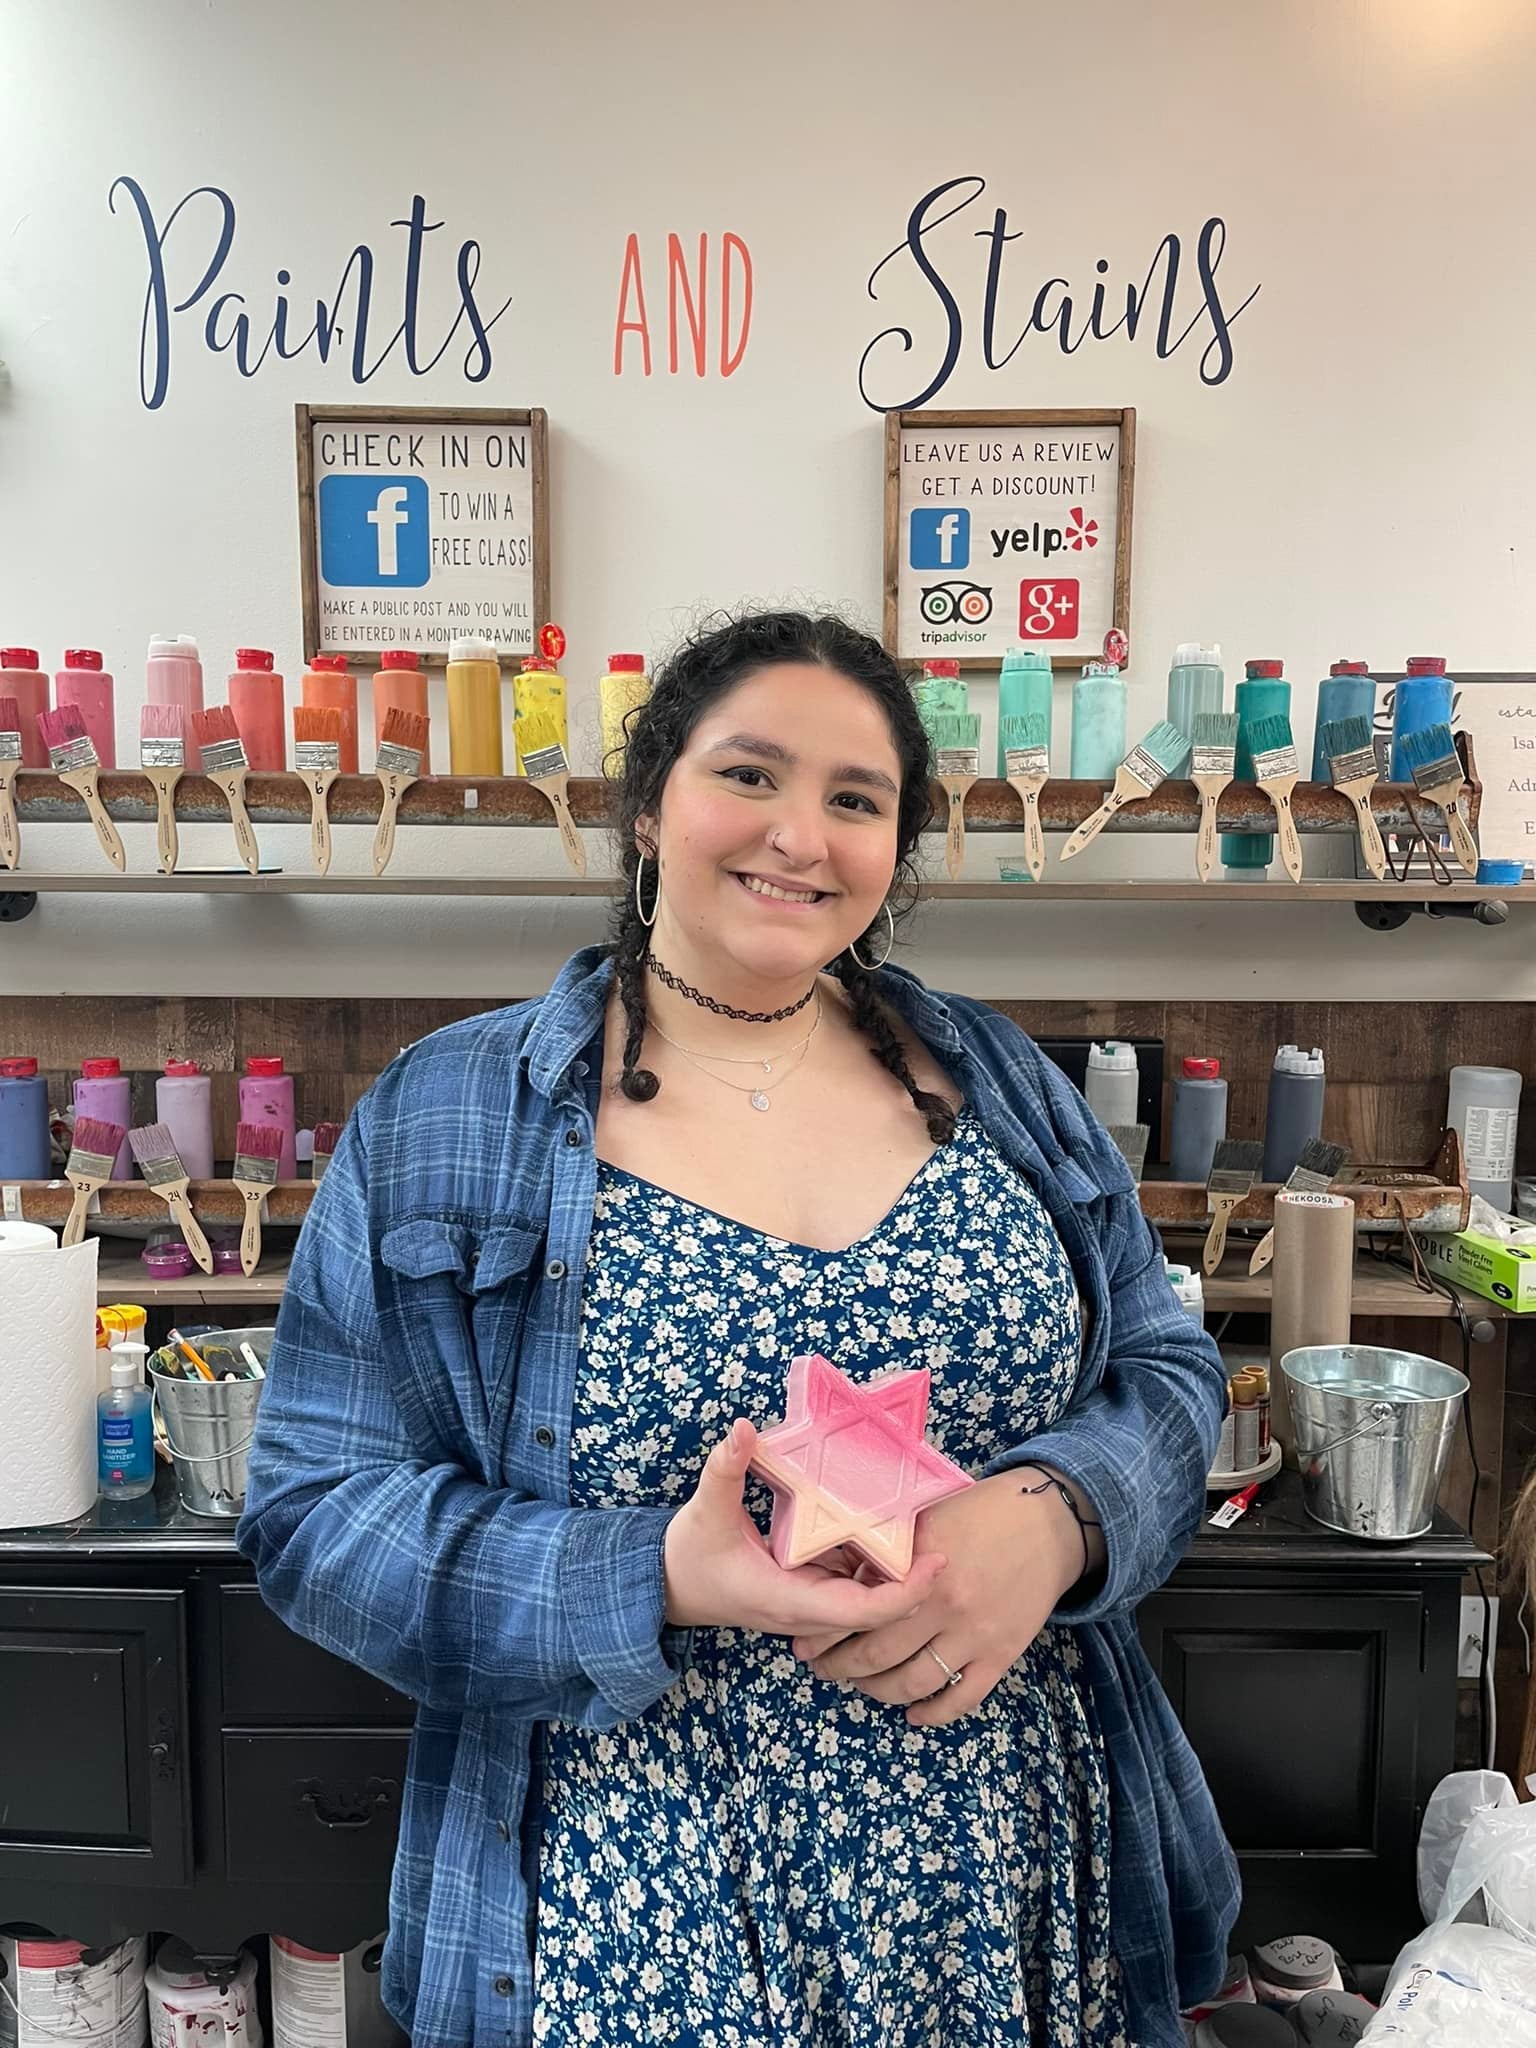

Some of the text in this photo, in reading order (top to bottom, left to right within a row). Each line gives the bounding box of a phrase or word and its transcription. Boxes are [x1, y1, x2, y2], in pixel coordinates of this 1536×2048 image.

[108, 174, 1262, 413] Paints AND Stains
[321, 434, 526, 468] CHECK IN ON
[904, 442, 1115, 463] LEAVE US A REVIEW
[922, 474, 1096, 496] GET A DISCOUNT!
[439, 492, 514, 521] TO WIN A
[367, 486, 409, 576] f
[935, 514, 960, 564] f
[432, 536, 532, 566] FREE CLASS!
[323, 600, 529, 618] MAKE A PUBLIC POST AND YOU WILL
[324, 626, 338, 641] BE
[342, 626, 395, 641] ENTERED
[399, 627, 410, 641] IN
[415, 627, 422, 641] A
[478, 628, 532, 643] DRAWING
[921, 631, 988, 645] tripadvisor
[1512, 735, 1536, 750] Isa
[83, 785, 93, 798] 3
[159, 782, 167, 796] 4
[227, 780, 236, 797] 5
[315, 781, 323, 795] 6
[553, 794, 561, 807] 9
[1112, 793, 1123, 805] 16
[1207, 795, 1216, 807] 17
[1358, 795, 1369, 810] 19
[1446, 801, 1456, 815] 20
[77, 1182, 91, 1192] 23
[168, 1190, 182, 1202] 24
[247, 1191, 260, 1201] 25
[1220, 1199, 1235, 1209] 37
